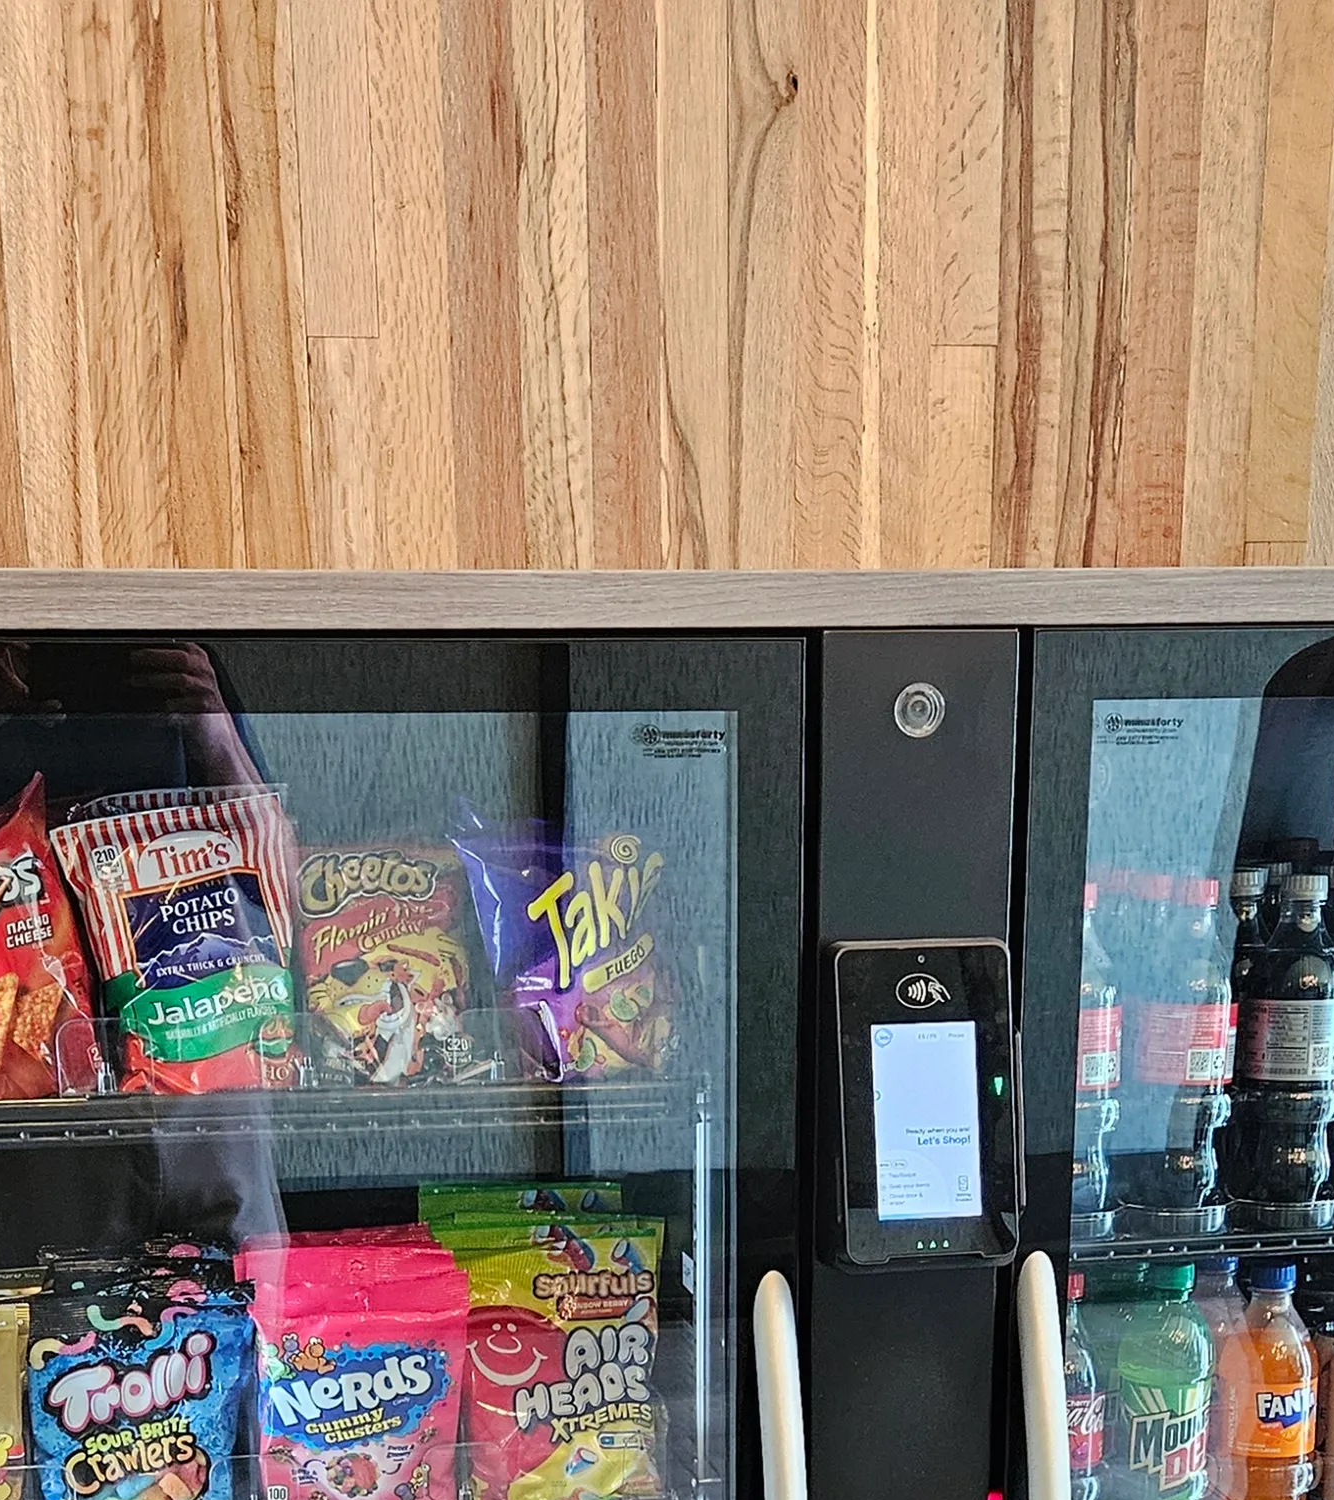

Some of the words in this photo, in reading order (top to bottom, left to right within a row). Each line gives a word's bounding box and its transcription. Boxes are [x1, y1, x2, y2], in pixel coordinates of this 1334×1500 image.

[95, 848, 115, 863] 210
[148, 840, 231, 880] Tim's
[299, 850, 437, 917] Cheetos
[159, 887, 239, 923] POTATO
[172, 908, 236, 935] CHIPS
[6, 913, 50, 935] NACHO
[6, 926, 52, 949] CHEESE
[312, 907, 389, 964] Flamin'
[358, 920, 425, 952] Crunchy
[156, 963, 185, 977] EXTRA
[187, 960, 214, 972] THICK
[217, 959, 224, 968] &
[226, 954, 266, 967] CRUNCHY
[604, 940, 645, 982] FUEGO
[148, 975, 289, 1026] Jalapeño
[917, 1136, 940, 1146] Let's
[943, 1135, 971, 1146] Shop!
[566, 1325, 651, 1380] AIR
[48, 1334, 212, 1432] Trolli
[516, 1364, 650, 1430] HEADS
[305, 1406, 385, 1435] gummy
[325, 1414, 402, 1444] clusters
[551, 1402, 653, 1443] XTREMES
[85, 1427, 135, 1455] SOUR
[65, 1434, 194, 1495] Crawlers
[269, 1488, 286, 1499] 100
